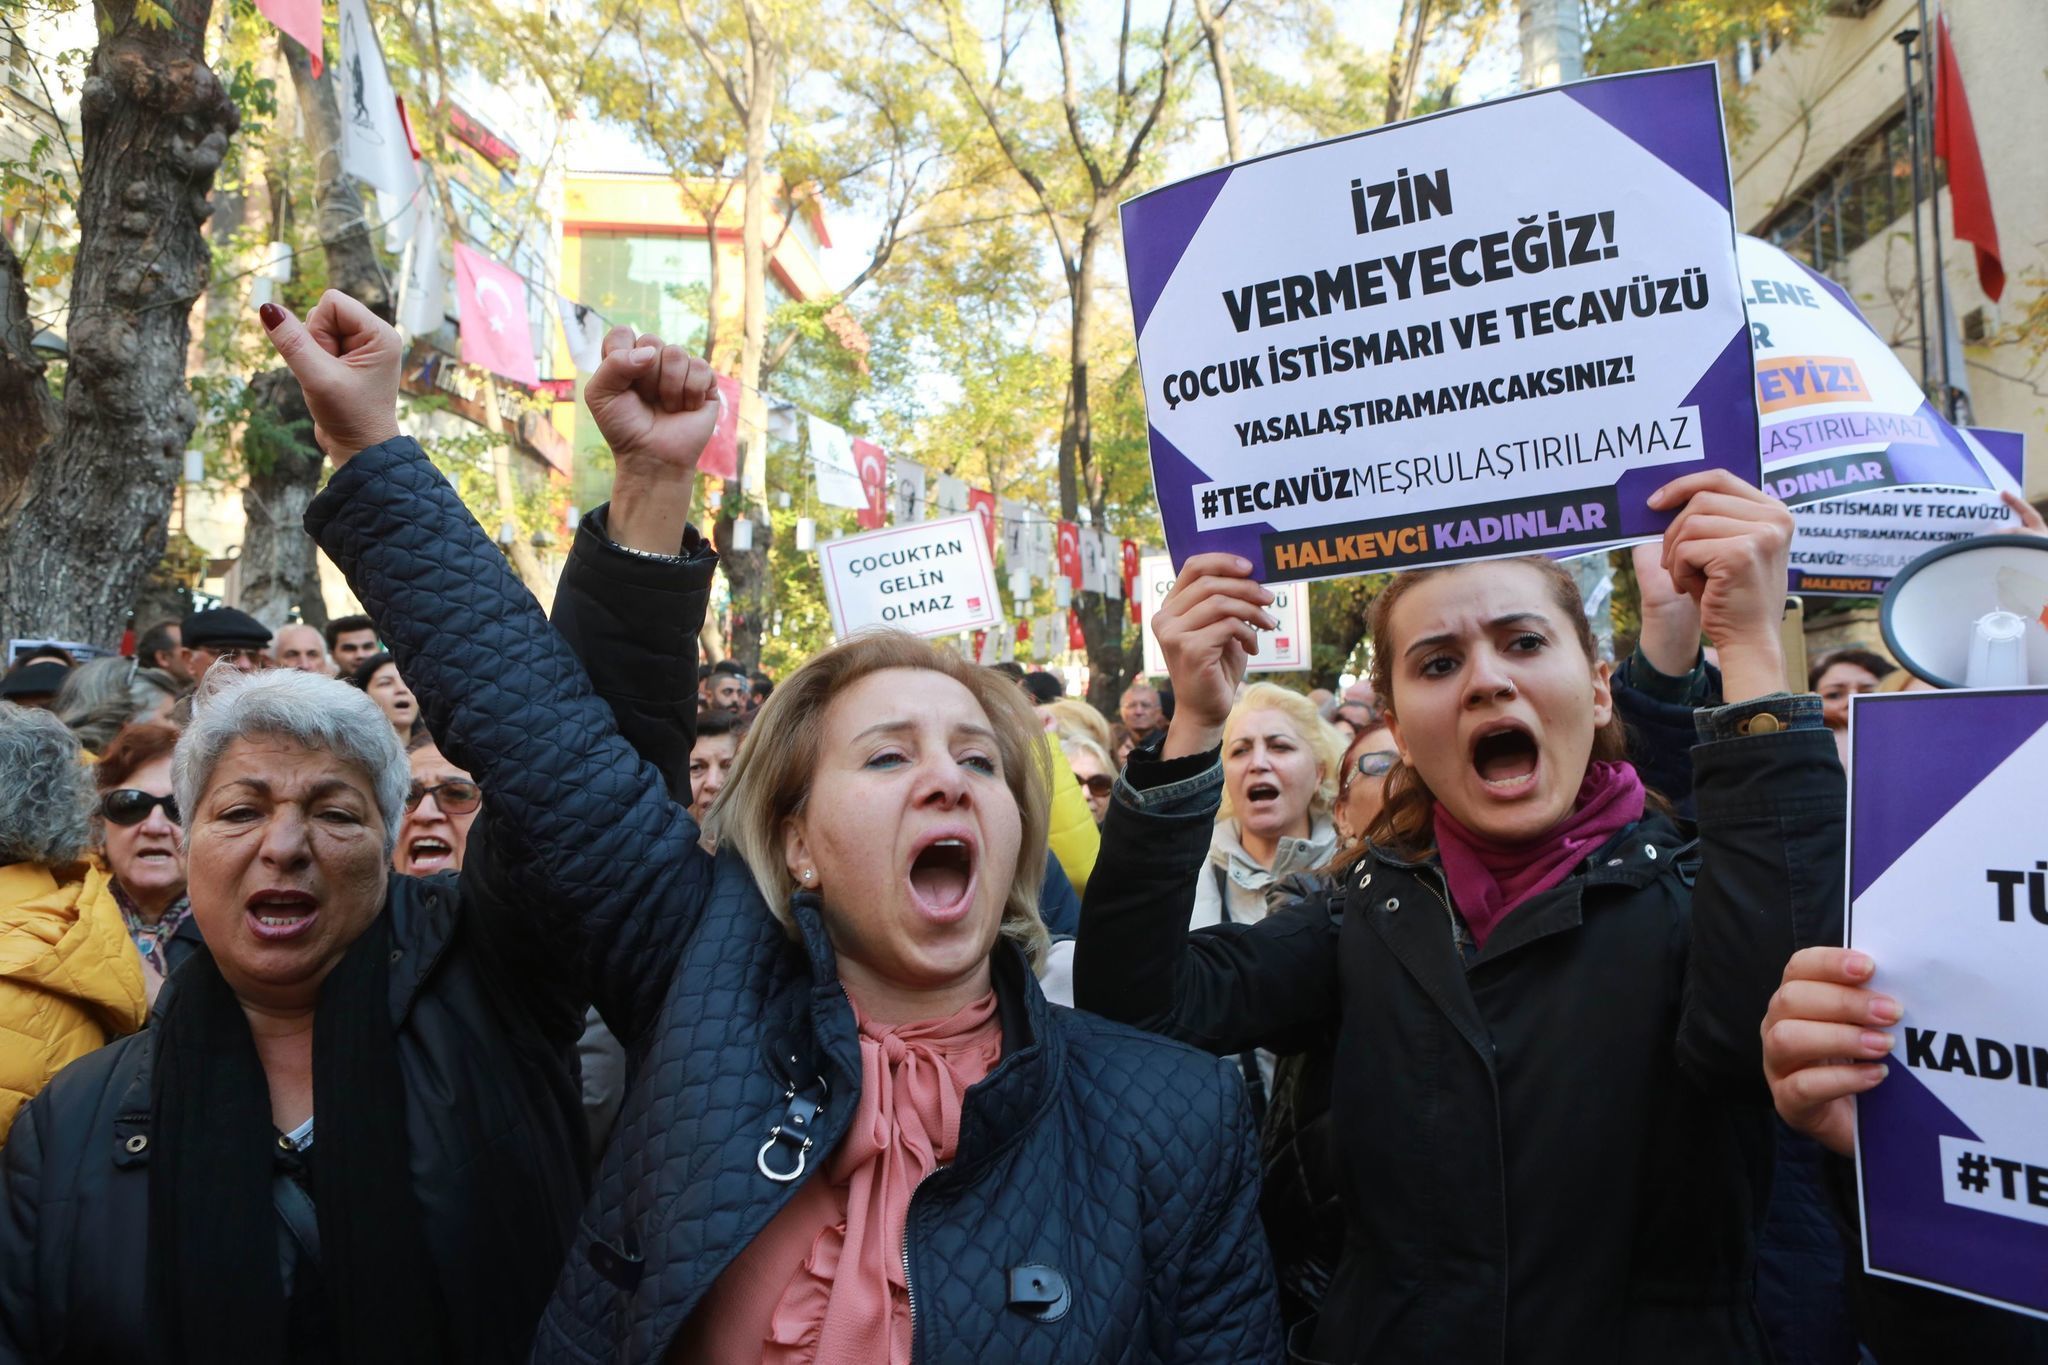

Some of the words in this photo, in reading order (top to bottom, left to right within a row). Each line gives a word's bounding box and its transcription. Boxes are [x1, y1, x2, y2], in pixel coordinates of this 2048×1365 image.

[1350, 167, 1454, 237] İZİN
[1222, 210, 1619, 333] VERMEYECEĞİZ!
[1162, 354, 1262, 411] ÇOCUK
[1269, 320, 1447, 382] İSTİSMARI
[1451, 310, 1500, 350] VE
[1505, 266, 1710, 339] TECAVÜZÜ
[1234, 355, 1636, 448] YASALAŞTIRAMAYACAKSINIZ!
[1201, 416, 1692, 520] #TECAVÜZMEŞRULAŞTIRILAMAZ
[1433, 502, 1606, 549] KADINLAR
[1903, 504, 1922, 517] VE
[1927, 503, 2010, 520] TECAVÜZÜ
[849, 540, 962, 577] ÇOCUKTAN
[880, 569, 944, 594] GELİN
[882, 595, 954, 621] OLMAZ
